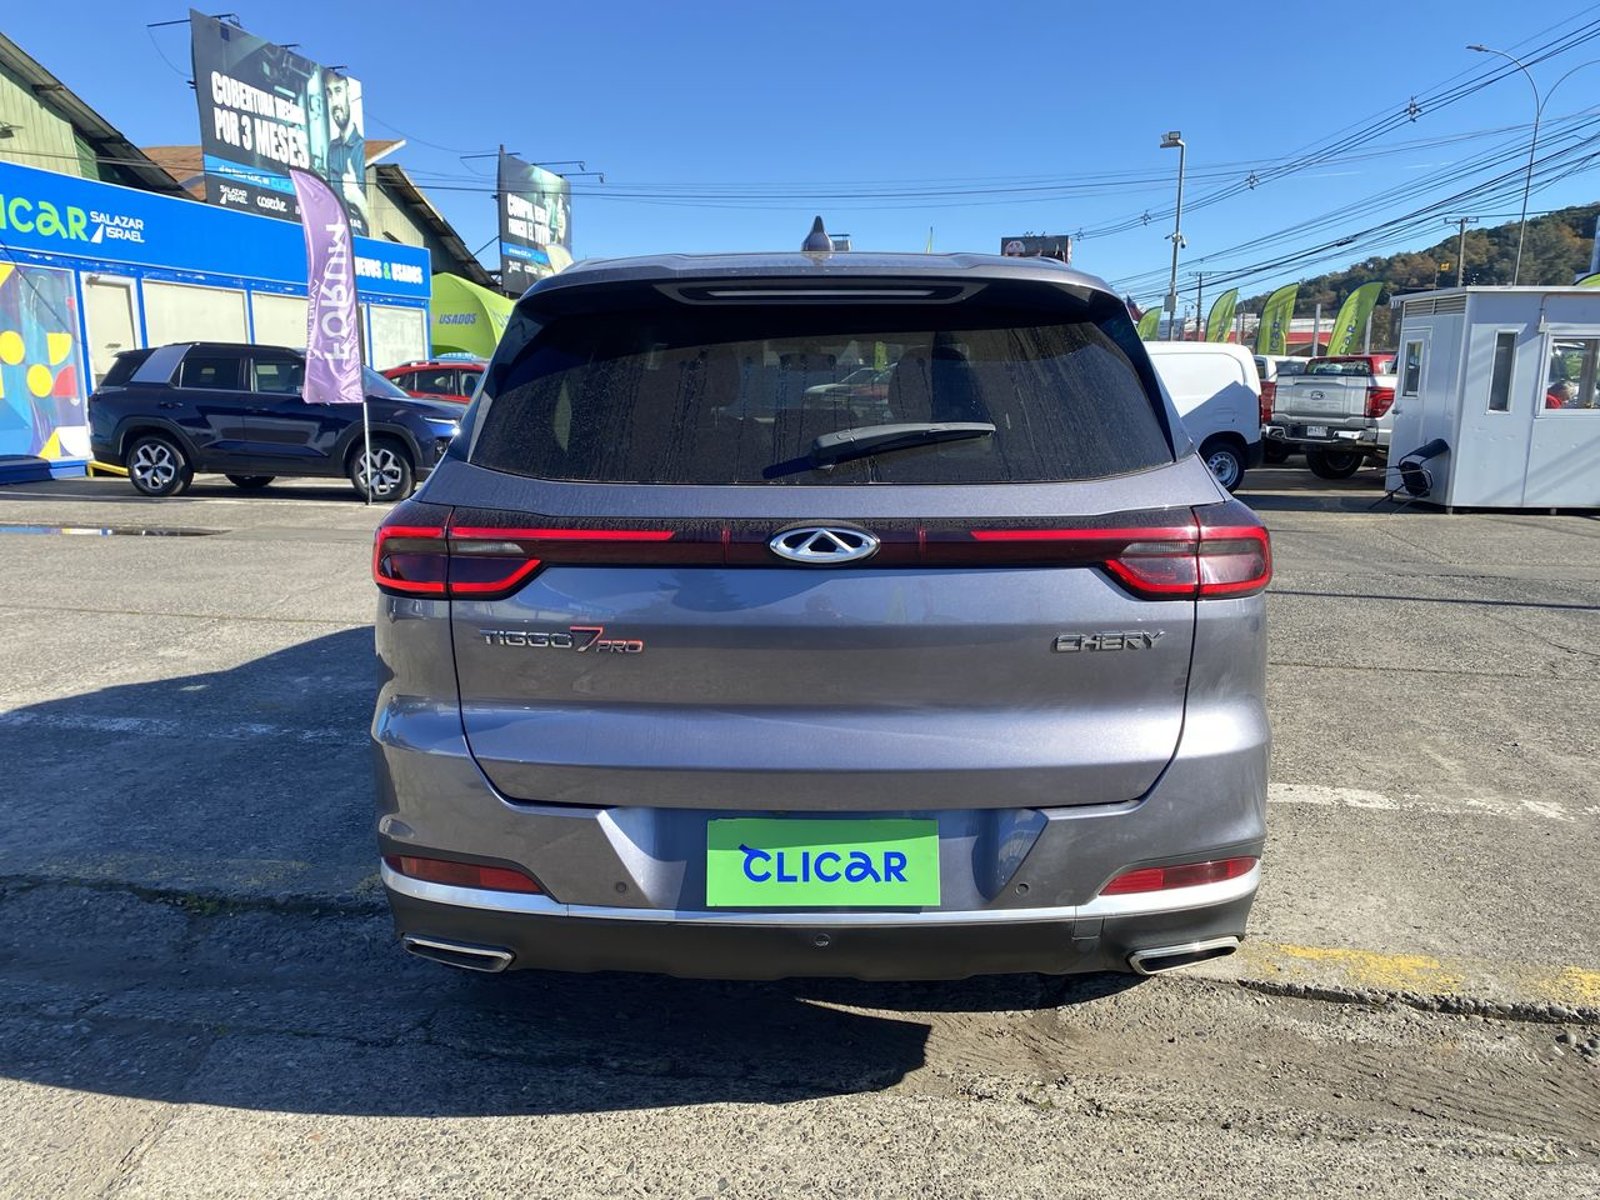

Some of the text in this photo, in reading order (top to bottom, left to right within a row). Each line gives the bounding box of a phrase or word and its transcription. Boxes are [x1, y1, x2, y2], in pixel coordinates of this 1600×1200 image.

[211, 70, 275, 118] COBERTURA
[213, 107, 310, 170] POR 3 MESES
[90, 210, 144, 231] SALAZAR
[105, 226, 145, 243] ISRAEL
[354, 256, 423, 285] UEVOS & USADOS
[439, 313, 477, 325] USADOS
[479, 626, 644, 653] TIGGO 7 PRO
[1050, 629, 1165, 654] CHERY
